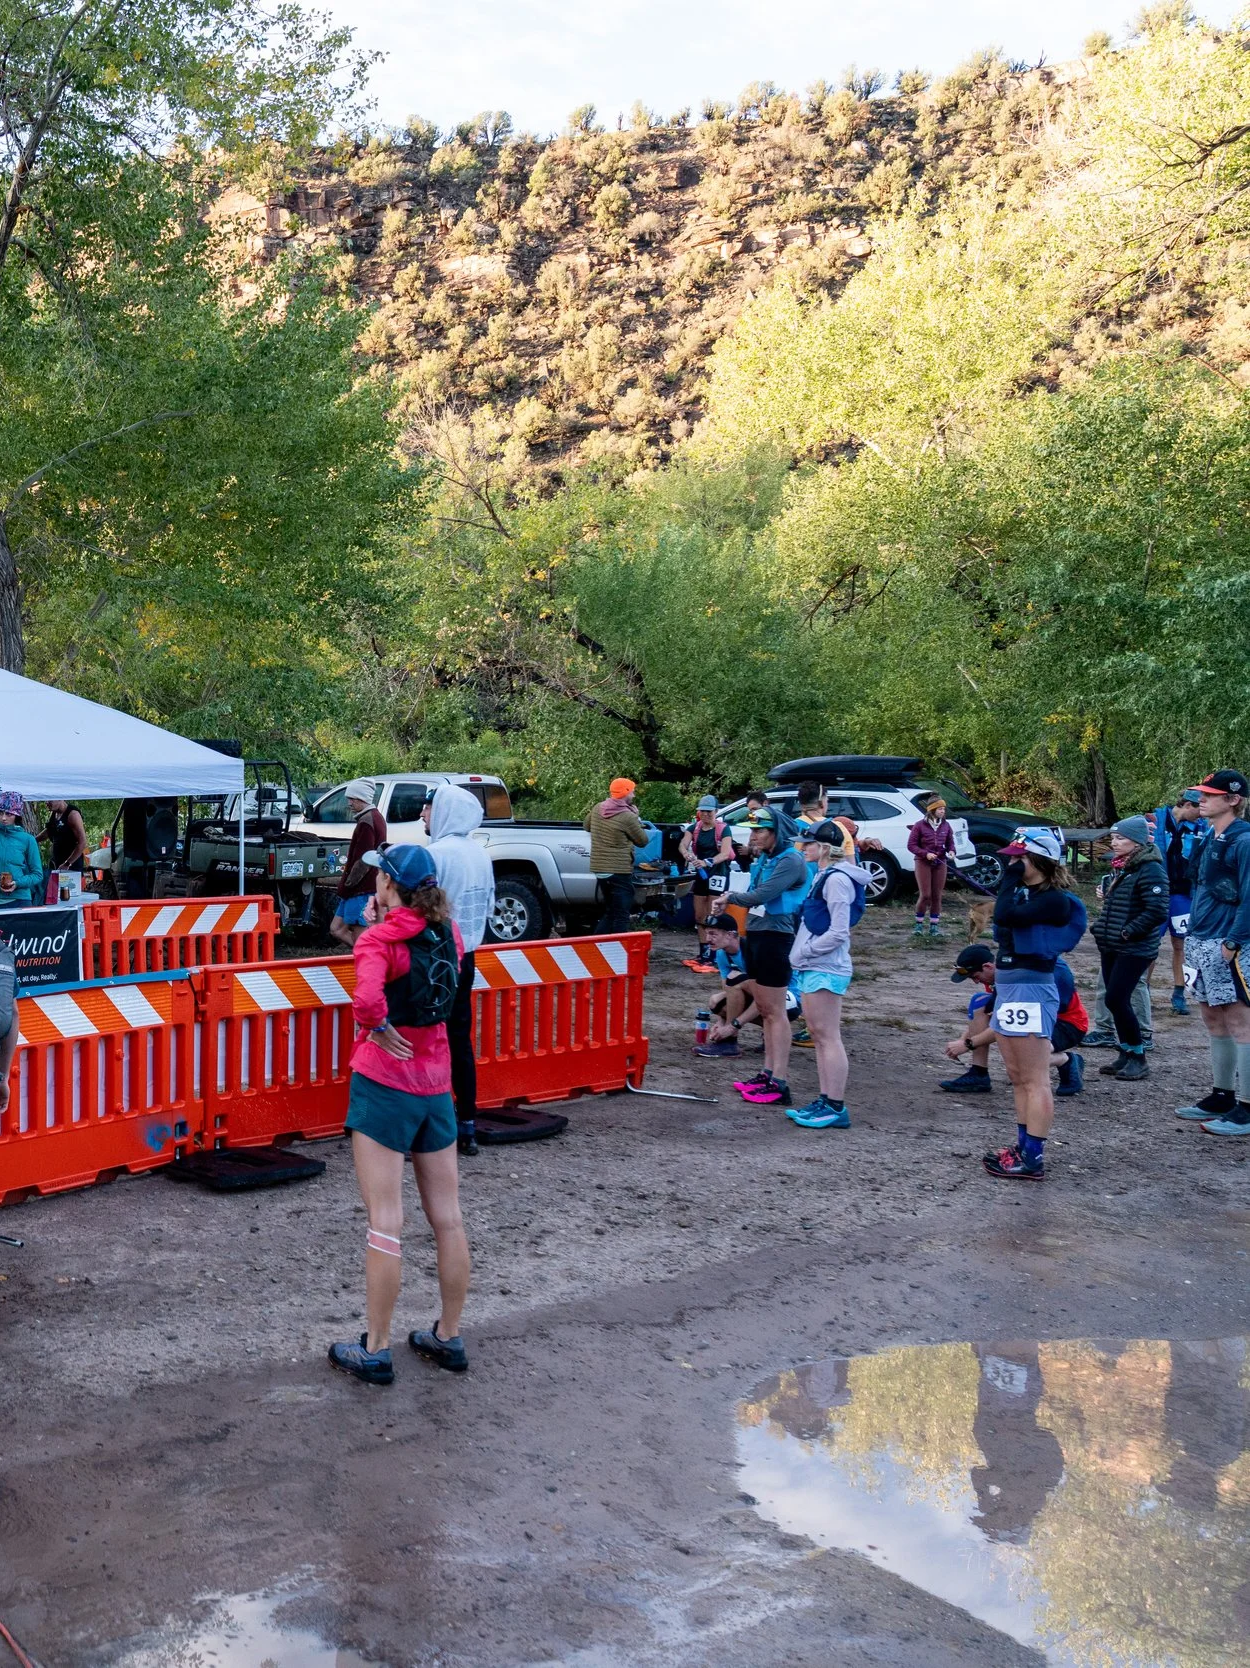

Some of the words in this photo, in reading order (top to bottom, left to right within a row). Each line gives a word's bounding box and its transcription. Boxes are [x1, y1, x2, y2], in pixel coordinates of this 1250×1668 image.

[710, 878, 723, 888] 31
[16, 956, 61, 967] NUTRITION
[1004, 1009, 1029, 1026] 39
